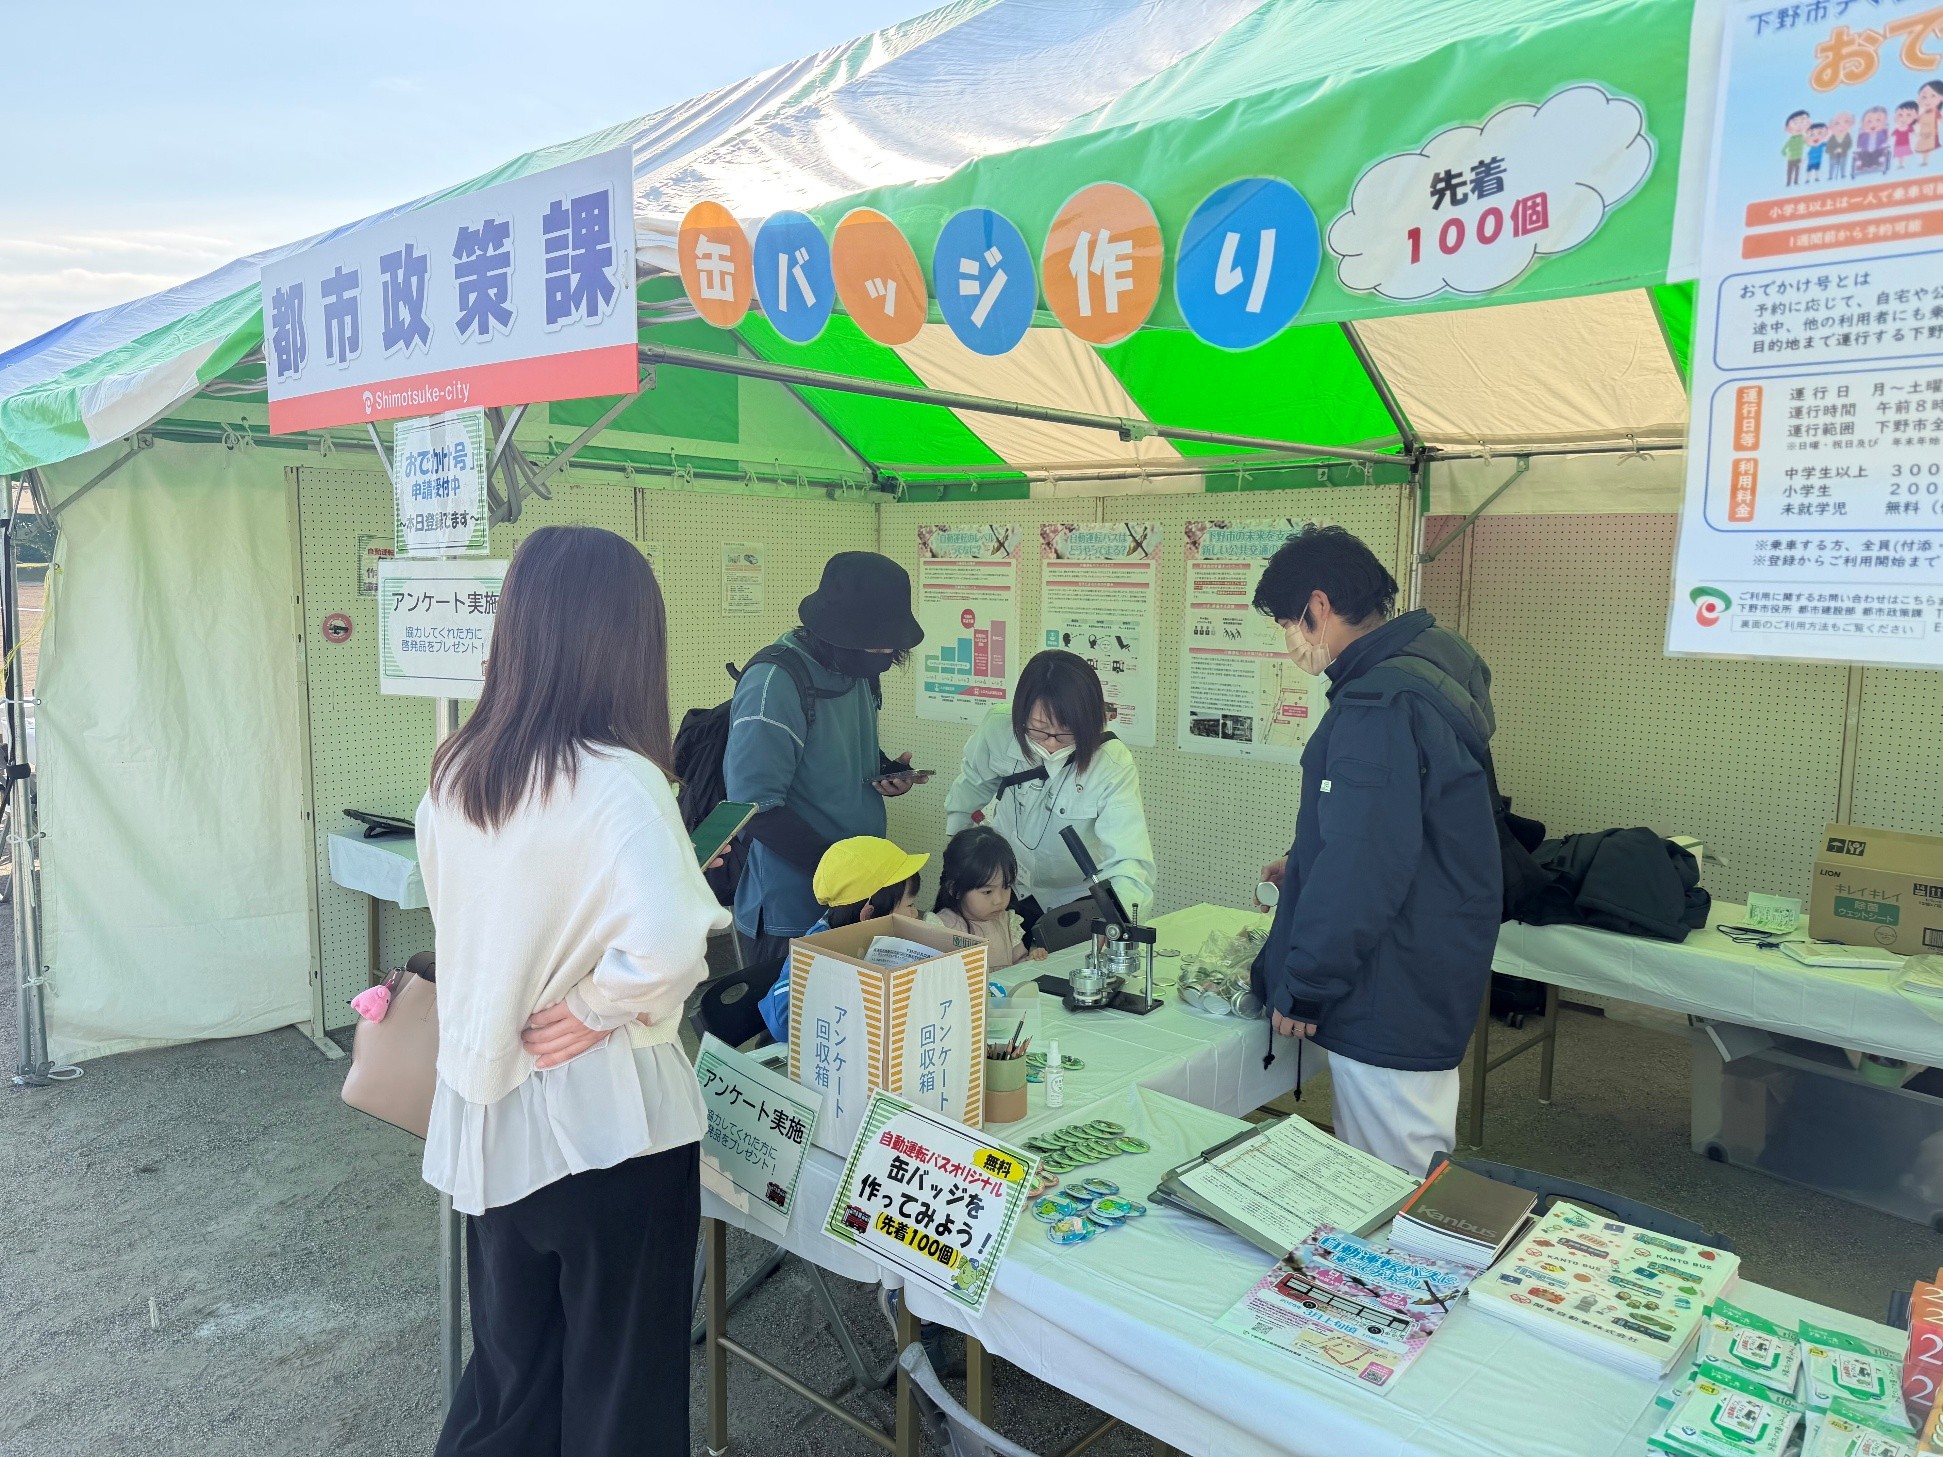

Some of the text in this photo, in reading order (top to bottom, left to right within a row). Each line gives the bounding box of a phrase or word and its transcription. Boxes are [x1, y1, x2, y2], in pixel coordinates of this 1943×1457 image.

[1428, 155, 1508, 211] 先着
[1406, 191, 1550, 265] 100個
[271, 188, 616, 378] 都市政策課
[1739, 271, 1872, 299] おでかけ号とは
[1752, 325, 1943, 354] 目的地まで運行する下野
[375, 380, 470, 410] Shimotsuke-city
[1738, 388, 1760, 448] 運行日等
[1788, 402, 1857, 420] 運行時間
[1787, 421, 1855, 438] 運行範囲
[1784, 465, 1869, 481] 中学生以上
[411, 475, 461, 501] 申請受付中
[1734, 460, 1755, 518] 利用料金
[1782, 483, 1833, 498] 小学生
[1780, 501, 1848, 516] 未就学児
[391, 591, 499, 614] アンケート実施
[1738, 603, 1793, 615] 下野市役所
[1797, 604, 1856, 616] 都市建設部
[1862, 606, 1923, 618] 都市政策課
[405, 626, 483, 640] 協力してくれた方に
[1819, 869, 1841, 878] LION
[1834, 883, 1903, 902] キレイキレイ
[1854, 901, 1879, 913] 除菌
[815, 1018, 831, 1089] 回収箱
[834, 1005, 848, 1119] アンケート
[919, 1024, 936, 1095] 回収箱
[938, 1000, 953, 1112] アンケート
[703, 1069, 806, 1145] アンケート実施
[879, 1130, 1004, 1198] 自動運転バスオリジナル
[982, 1153, 1013, 1179] 無料
[886, 1155, 985, 1220] 缶バッジを
[858, 1173, 993, 1255] 作ってみよう！
[1416, 1204, 1498, 1238] Kanbus
[1547, 1254, 1602, 1272] KANTO BUS
[1656, 1254, 1713, 1270] KANTO BUS
